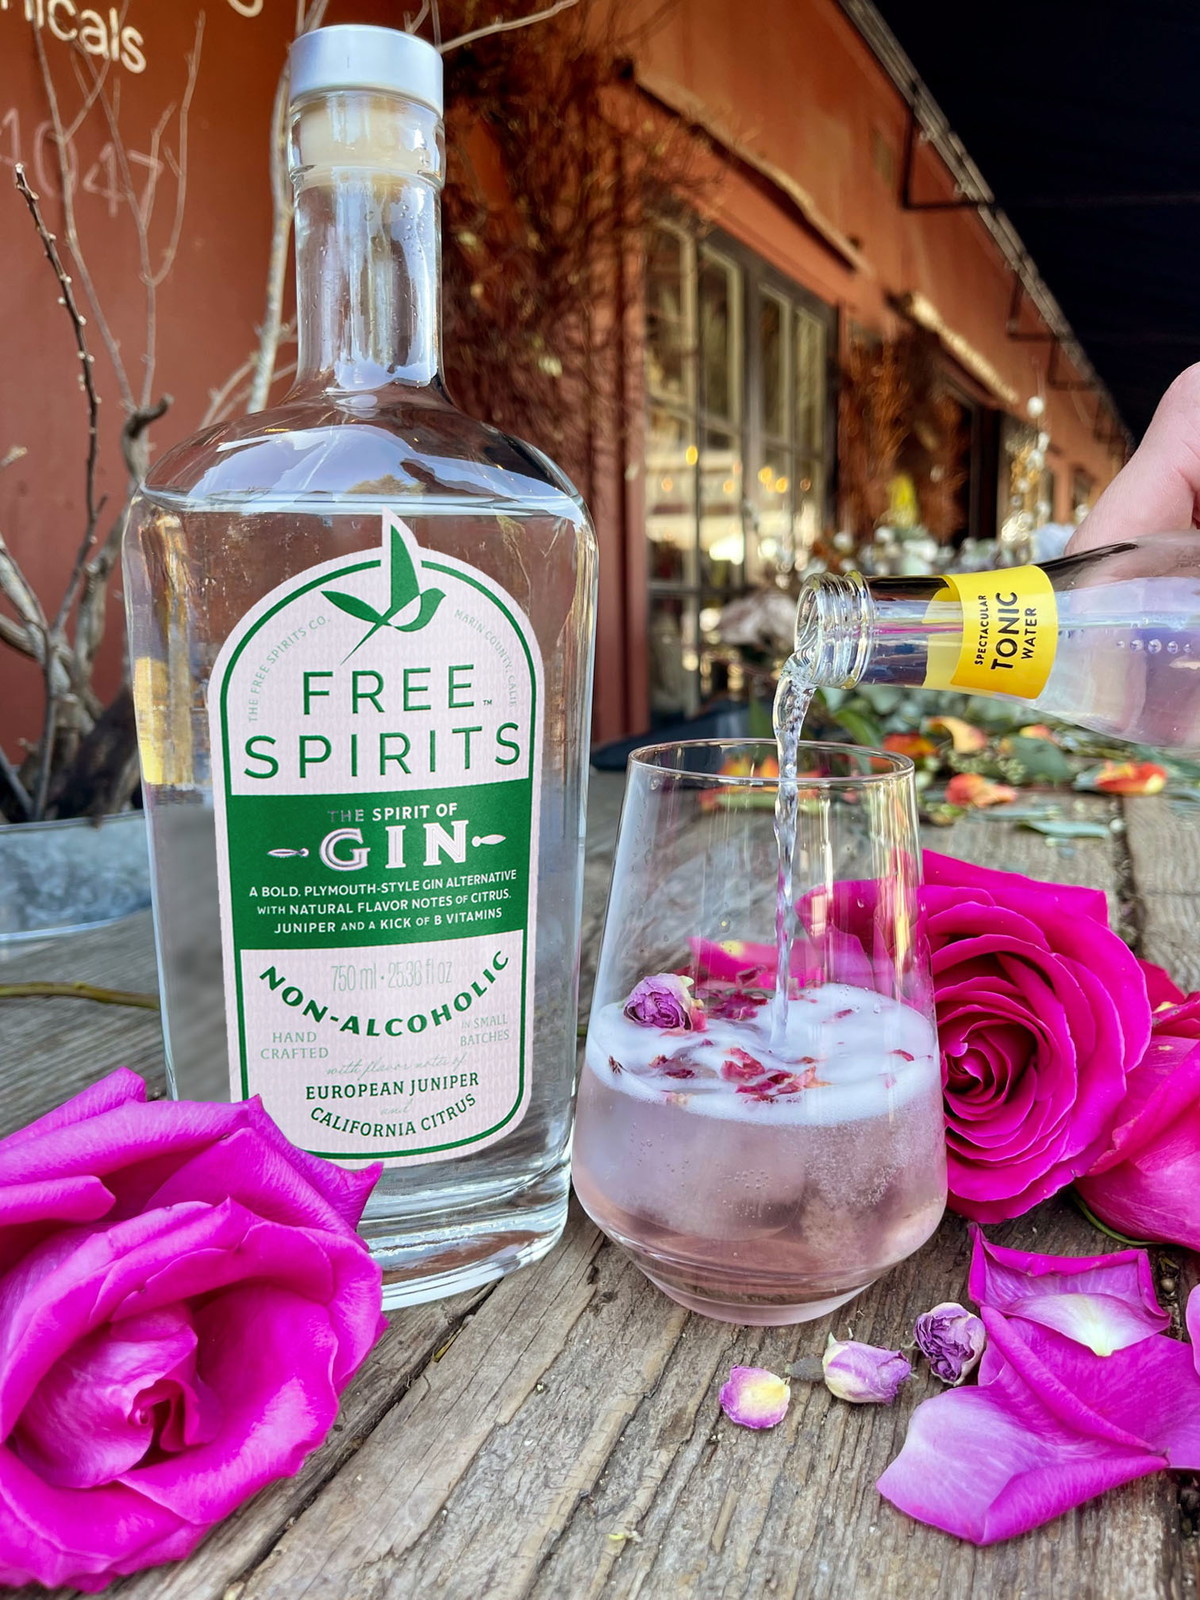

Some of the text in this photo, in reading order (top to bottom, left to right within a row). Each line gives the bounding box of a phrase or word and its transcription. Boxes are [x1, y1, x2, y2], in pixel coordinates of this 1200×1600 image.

[454, 609, 485, 633] MARIN
[975, 595, 989, 665] SPECTACULAR
[991, 591, 1020, 669] TONIC
[1021, 607, 1037, 660] WATER
[248, 615, 331, 722] THE FREE SPIRITS CO.
[303, 664, 474, 715] FREE
[244, 722, 520, 779] SPIRITS
[327, 802, 458, 822] THE SPIRIT OF
[319, 819, 469, 871] GIN
[249, 886, 258, 897] A
[304, 881, 420, 897] PLYMOUTH-STYLE
[422, 879, 443, 890] GIN
[446, 869, 517, 888] ALTERNATIVE
[257, 905, 286, 915] WITH
[289, 903, 354, 915] NATURAL
[357, 899, 409, 913] FLAVOR
[411, 895, 453, 909] NOTES
[455, 895, 468, 905] OF
[274, 907, 503, 934] JUNIPER AND A KICK OF B VITAMINS
[330, 965, 356, 992] 750
[360, 963, 377, 990] ml
[437, 961, 453, 984] oz
[259, 950, 510, 1037] NON-ALCOHOLIC
[473, 1014, 508, 1029] SMALL
[272, 1031, 317, 1043] HAND
[460, 1029, 510, 1047] BATCHES
[260, 1047, 329, 1060] CRAFTED
[326, 1058, 363, 1075] with
[357, 1057, 410, 1081] flavor
[305, 1072, 480, 1100] EUROPEAN JUNIPER
[310, 1093, 477, 1138] CALIFORNIA CITRUS
[380, 1098, 414, 1116] and
